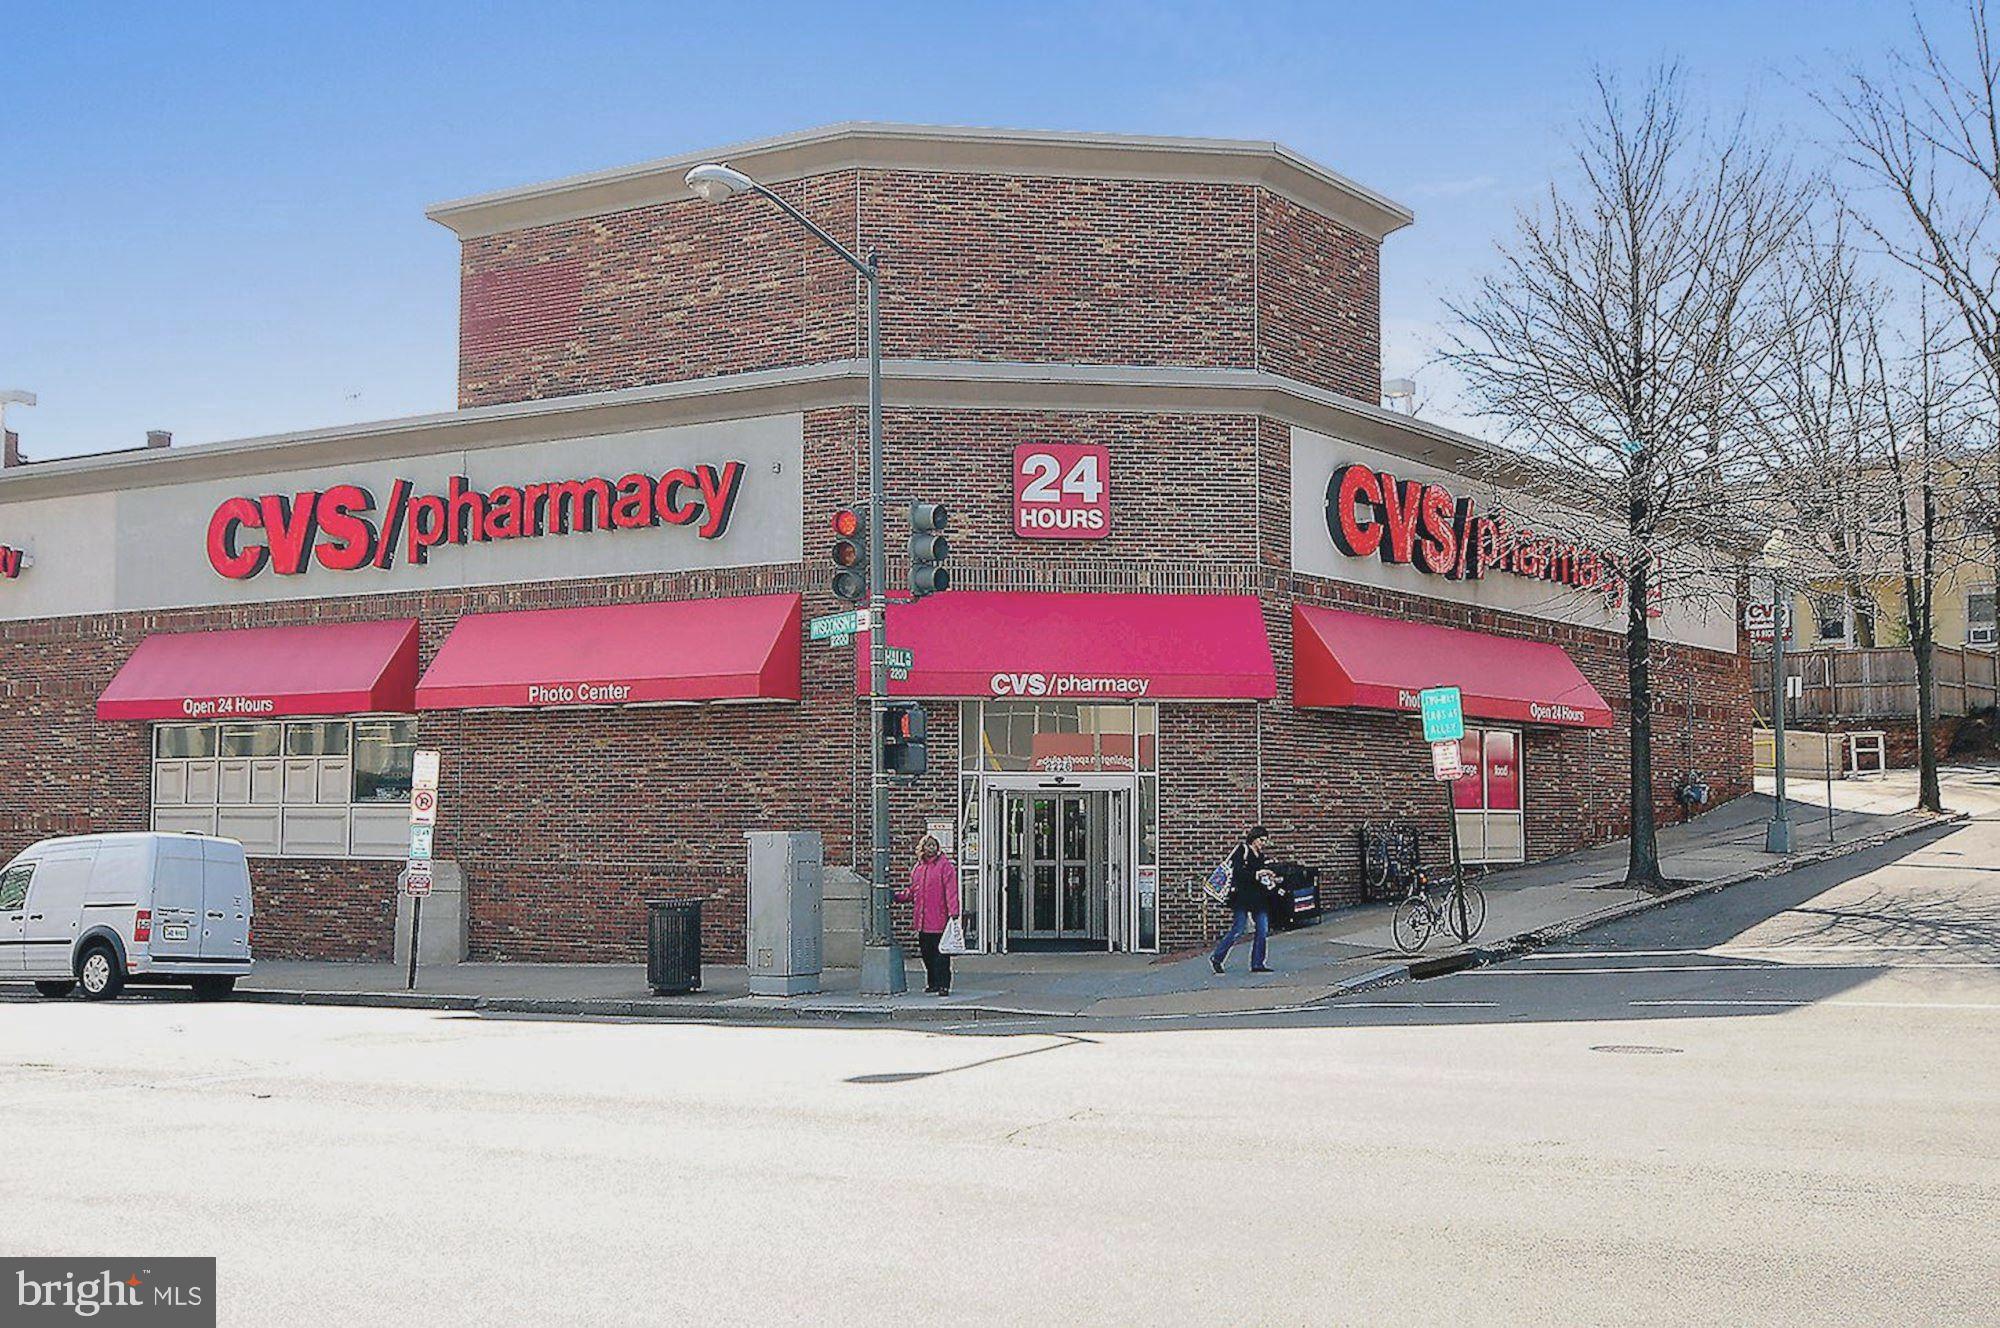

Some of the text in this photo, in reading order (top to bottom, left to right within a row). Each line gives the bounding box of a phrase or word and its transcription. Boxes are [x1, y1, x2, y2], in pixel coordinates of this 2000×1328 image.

[1021, 453, 1103, 503] 24
[207, 461, 746, 579] CVS/pharmacy
[1020, 507, 1104, 529] HOURS
[528, 683, 632, 703] Photo Center
[990, 673, 1150, 696] CVS/pharmacy
[183, 697, 275, 718] Open 24 Hours
[1529, 702, 1585, 722] Open 24 Hours
